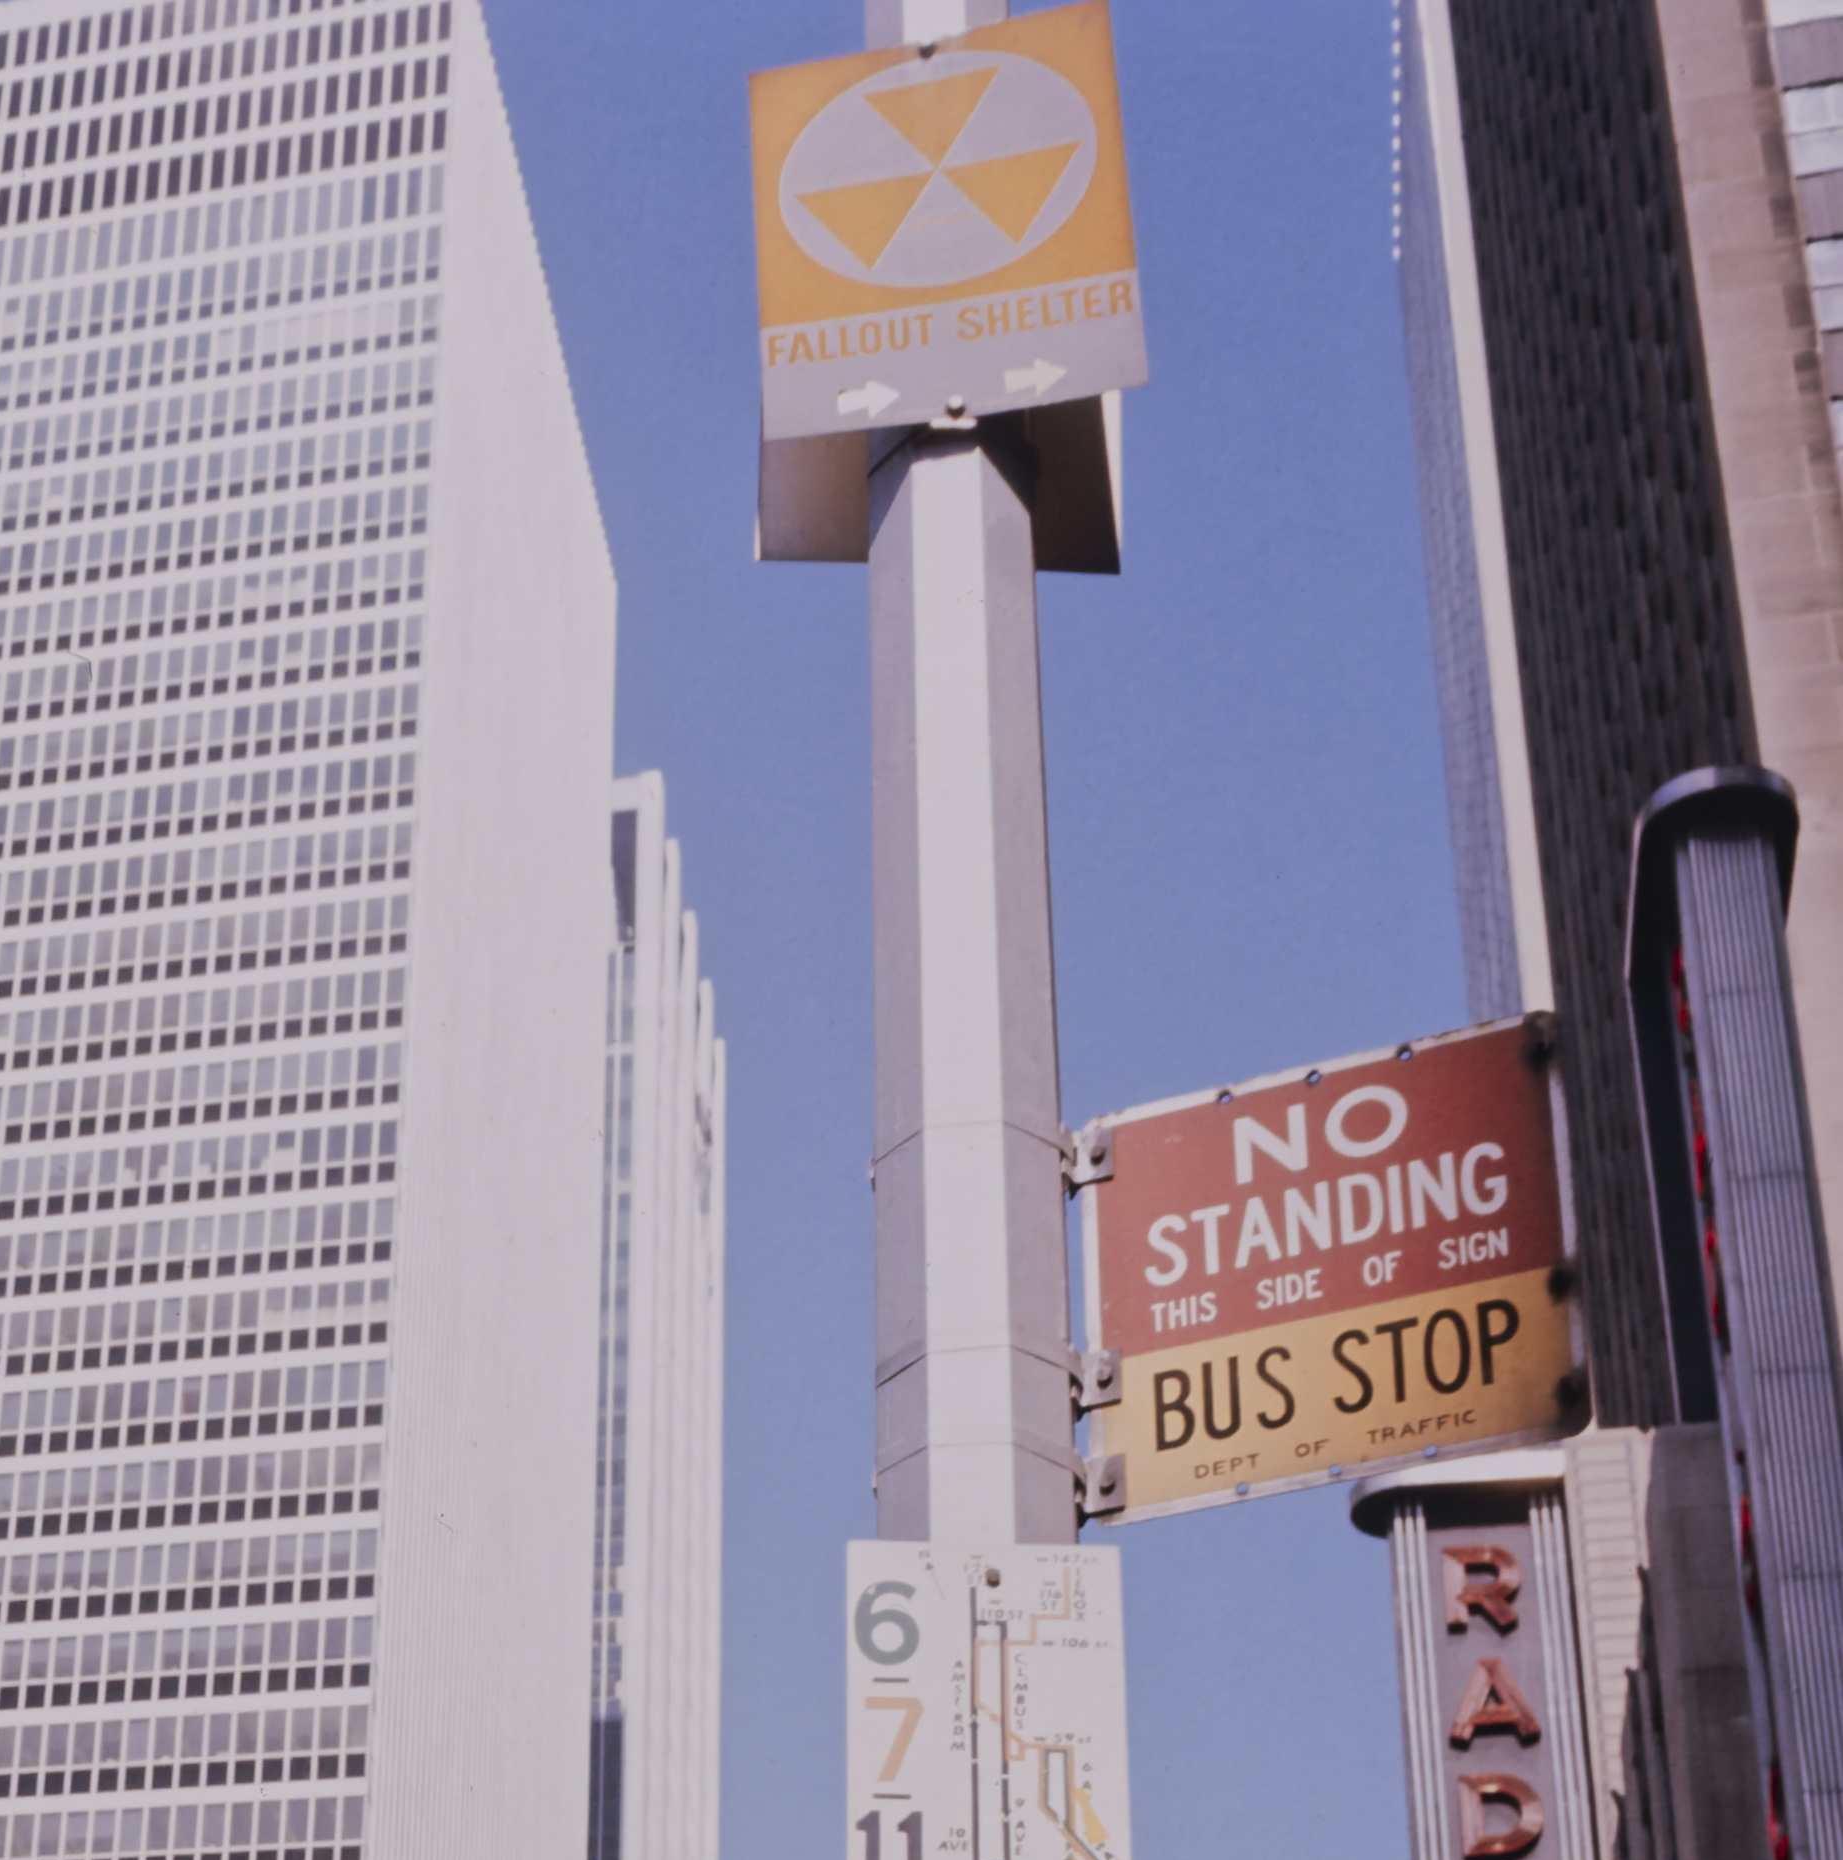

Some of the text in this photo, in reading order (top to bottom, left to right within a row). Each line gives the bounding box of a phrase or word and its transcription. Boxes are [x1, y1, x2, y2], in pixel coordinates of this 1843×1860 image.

[766, 279, 1134, 368] FALLOUT SHELTER
[1233, 1084, 1409, 1186] NO
[1144, 1141, 1509, 1287] STANDING
[1150, 1228, 1510, 1333] THIS SIDE OF SIGN
[1153, 1299, 1520, 1454] BUS STOP
[1193, 1409, 1477, 1480] DEPT OF TRAFFIC
[854, 1580, 921, 1666] 6
[1061, 1637, 1089, 1649] 106
[864, 1696, 925, 1783] 7
[937, 1840, 970, 1852] AVE
[948, 1827, 966, 1839] 10
